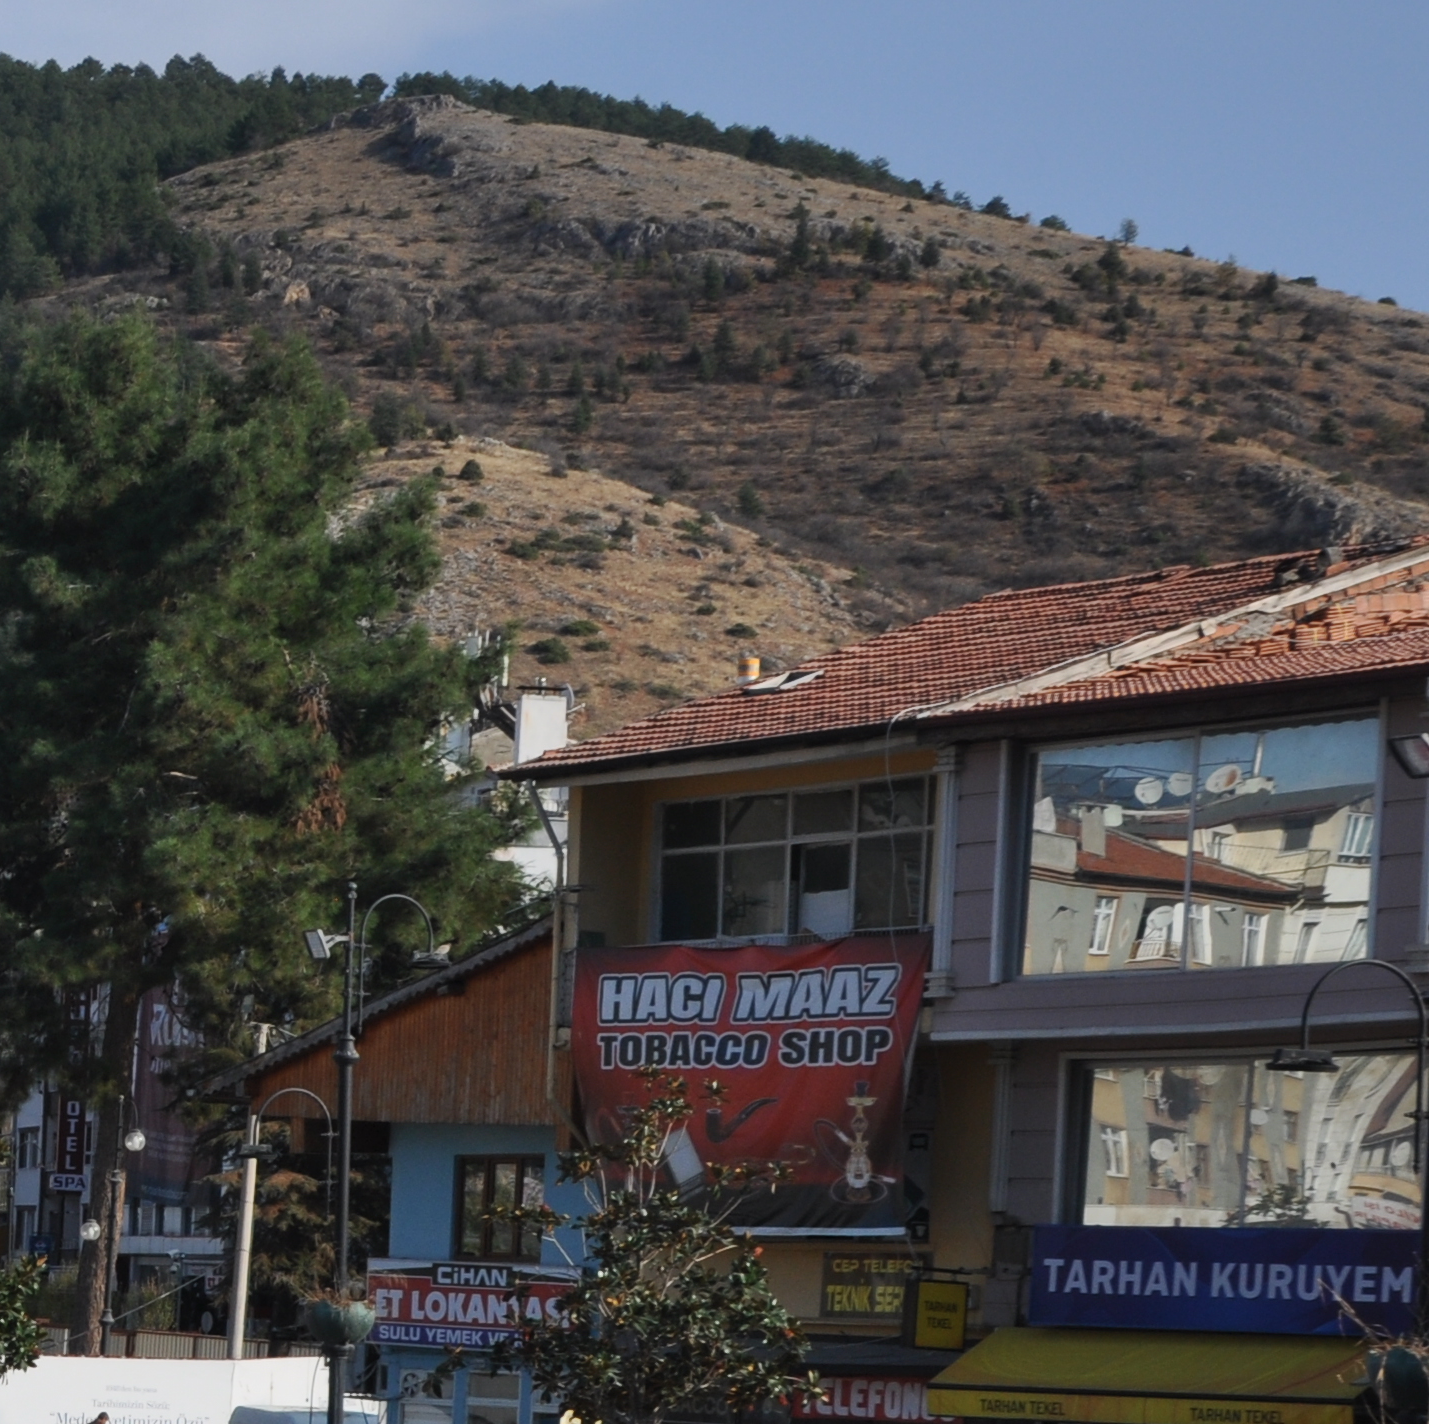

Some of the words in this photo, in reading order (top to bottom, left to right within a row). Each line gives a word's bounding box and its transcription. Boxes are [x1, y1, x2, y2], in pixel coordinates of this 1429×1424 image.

[598, 972, 726, 1026] HACI
[732, 962, 901, 1024] MAAZ
[598, 1030, 771, 1069] TOBACCO
[779, 1026, 892, 1067] SHOP
[53, 1176, 86, 1189] SPA
[832, 1259, 860, 1273] CEP
[1043, 1258, 1198, 1298] TARHAN
[1210, 1262, 1413, 1304] KURUYEM
[375, 1288, 404, 1318] ET
[826, 1278, 872, 1312] TEKNİK
[924, 1300, 958, 1313] TARHAN
[379, 1325, 421, 1341] SULU
[425, 1327, 483, 1345] YEMEK
[980, 1399, 1028, 1415] TARHAN
[1030, 1401, 1065, 1416] TEKEL
[1190, 1407, 1241, 1424] TARHAN
